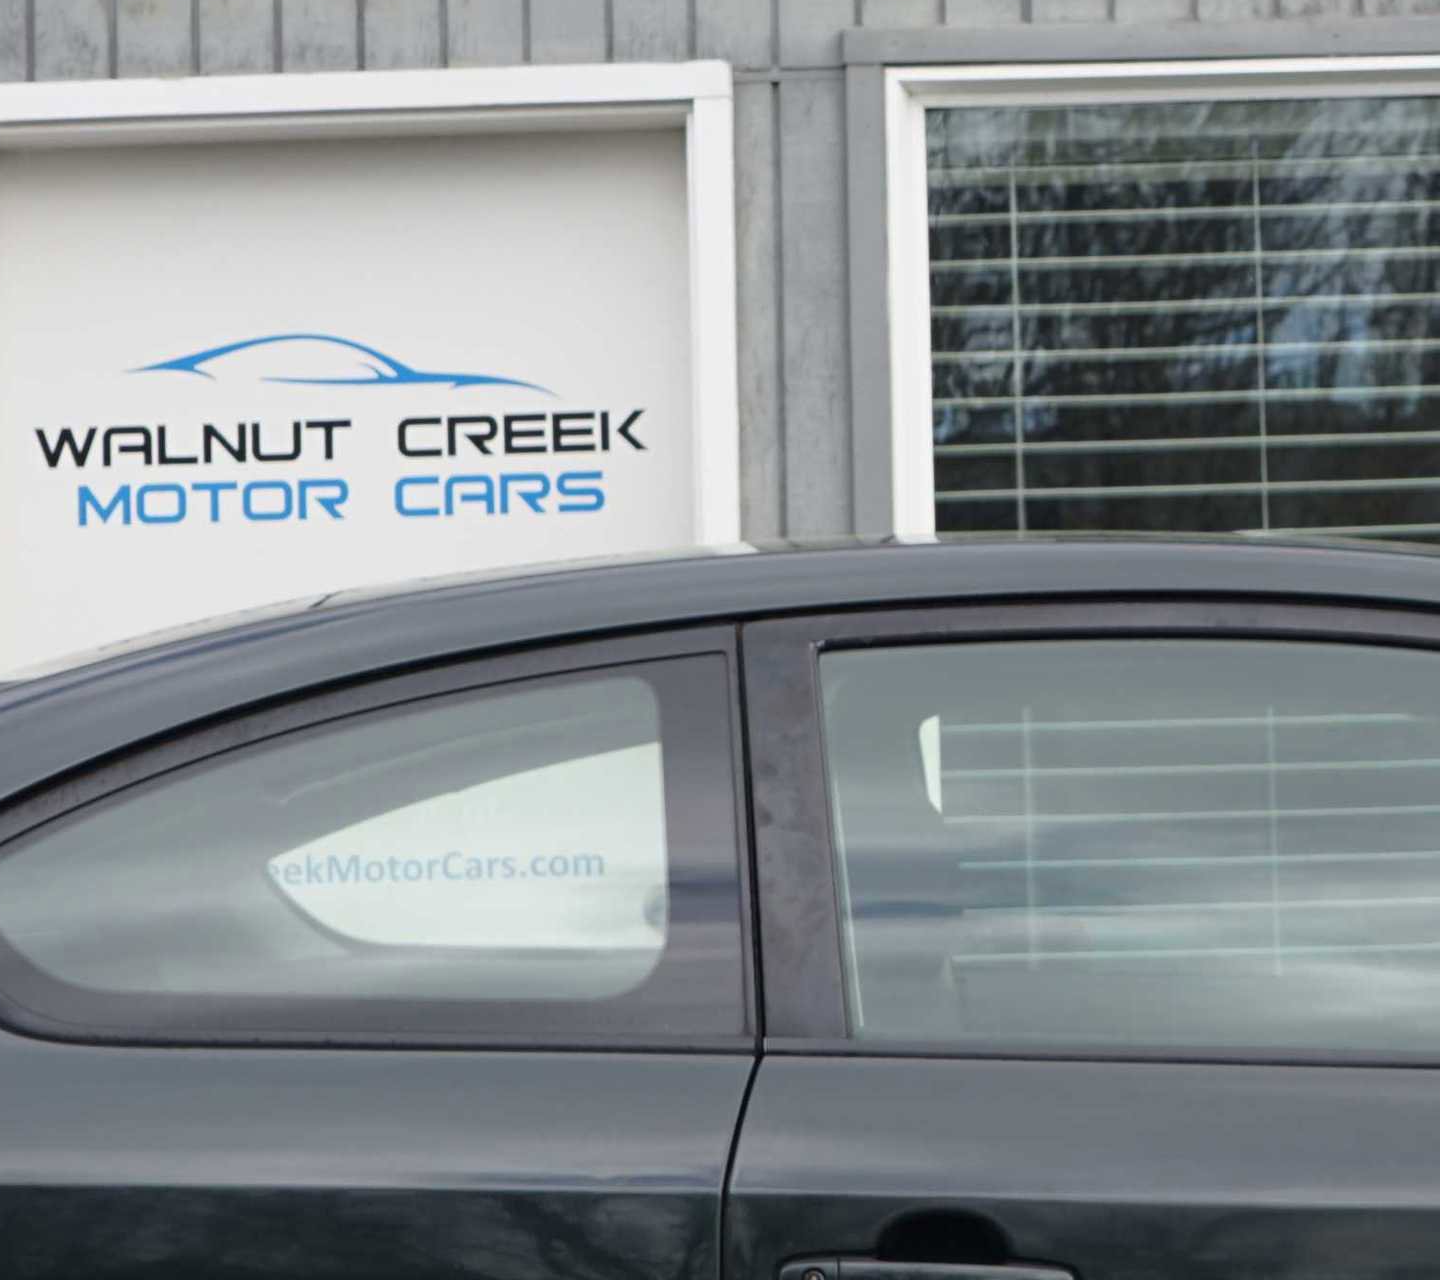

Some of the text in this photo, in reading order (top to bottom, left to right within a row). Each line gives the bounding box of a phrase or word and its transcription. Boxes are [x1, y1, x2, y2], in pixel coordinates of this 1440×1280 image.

[35, 408, 648, 468] WALNUT CREEK
[76, 469, 606, 527] MOTOR CARS
